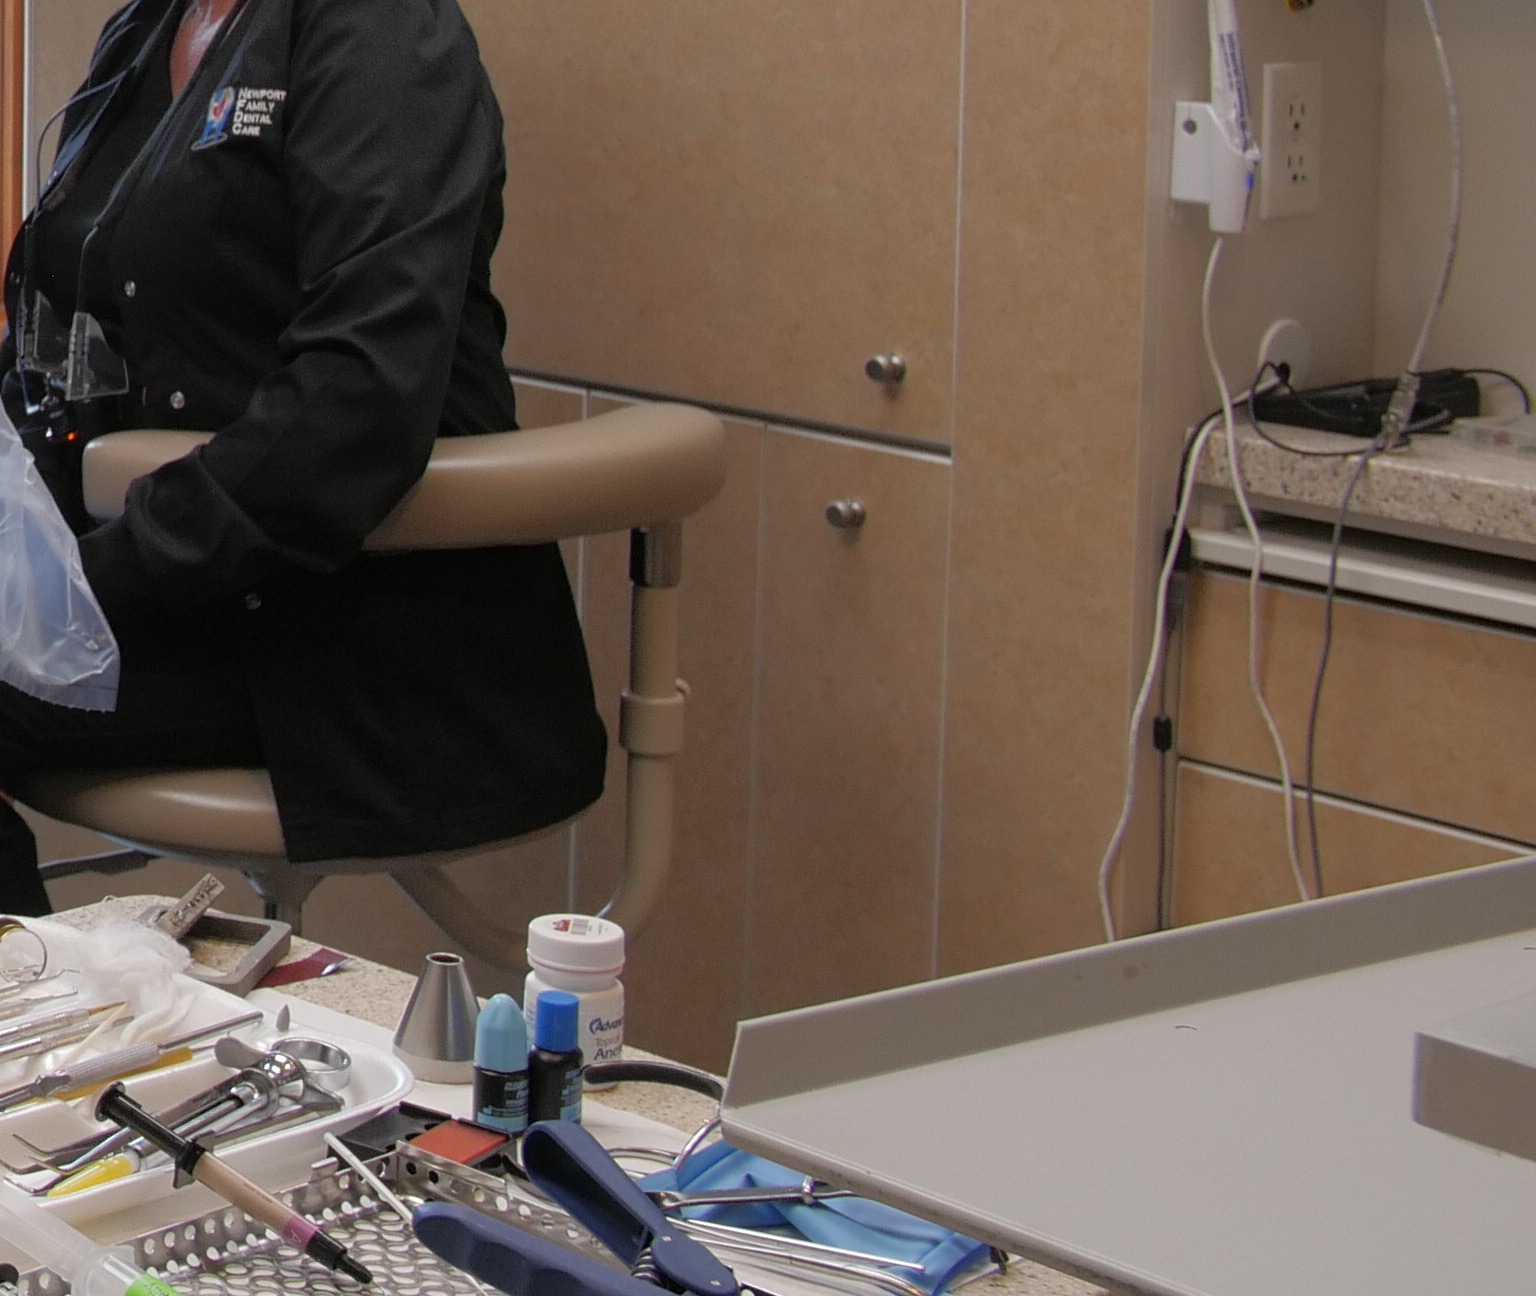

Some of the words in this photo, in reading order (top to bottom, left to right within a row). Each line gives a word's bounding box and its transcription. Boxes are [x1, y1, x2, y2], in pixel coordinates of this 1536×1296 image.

[239, 87, 287, 101] NEWPORT
[236, 99, 276, 114] FAMILY
[233, 111, 273, 125] DENTAL
[232, 123, 261, 136] CARE
